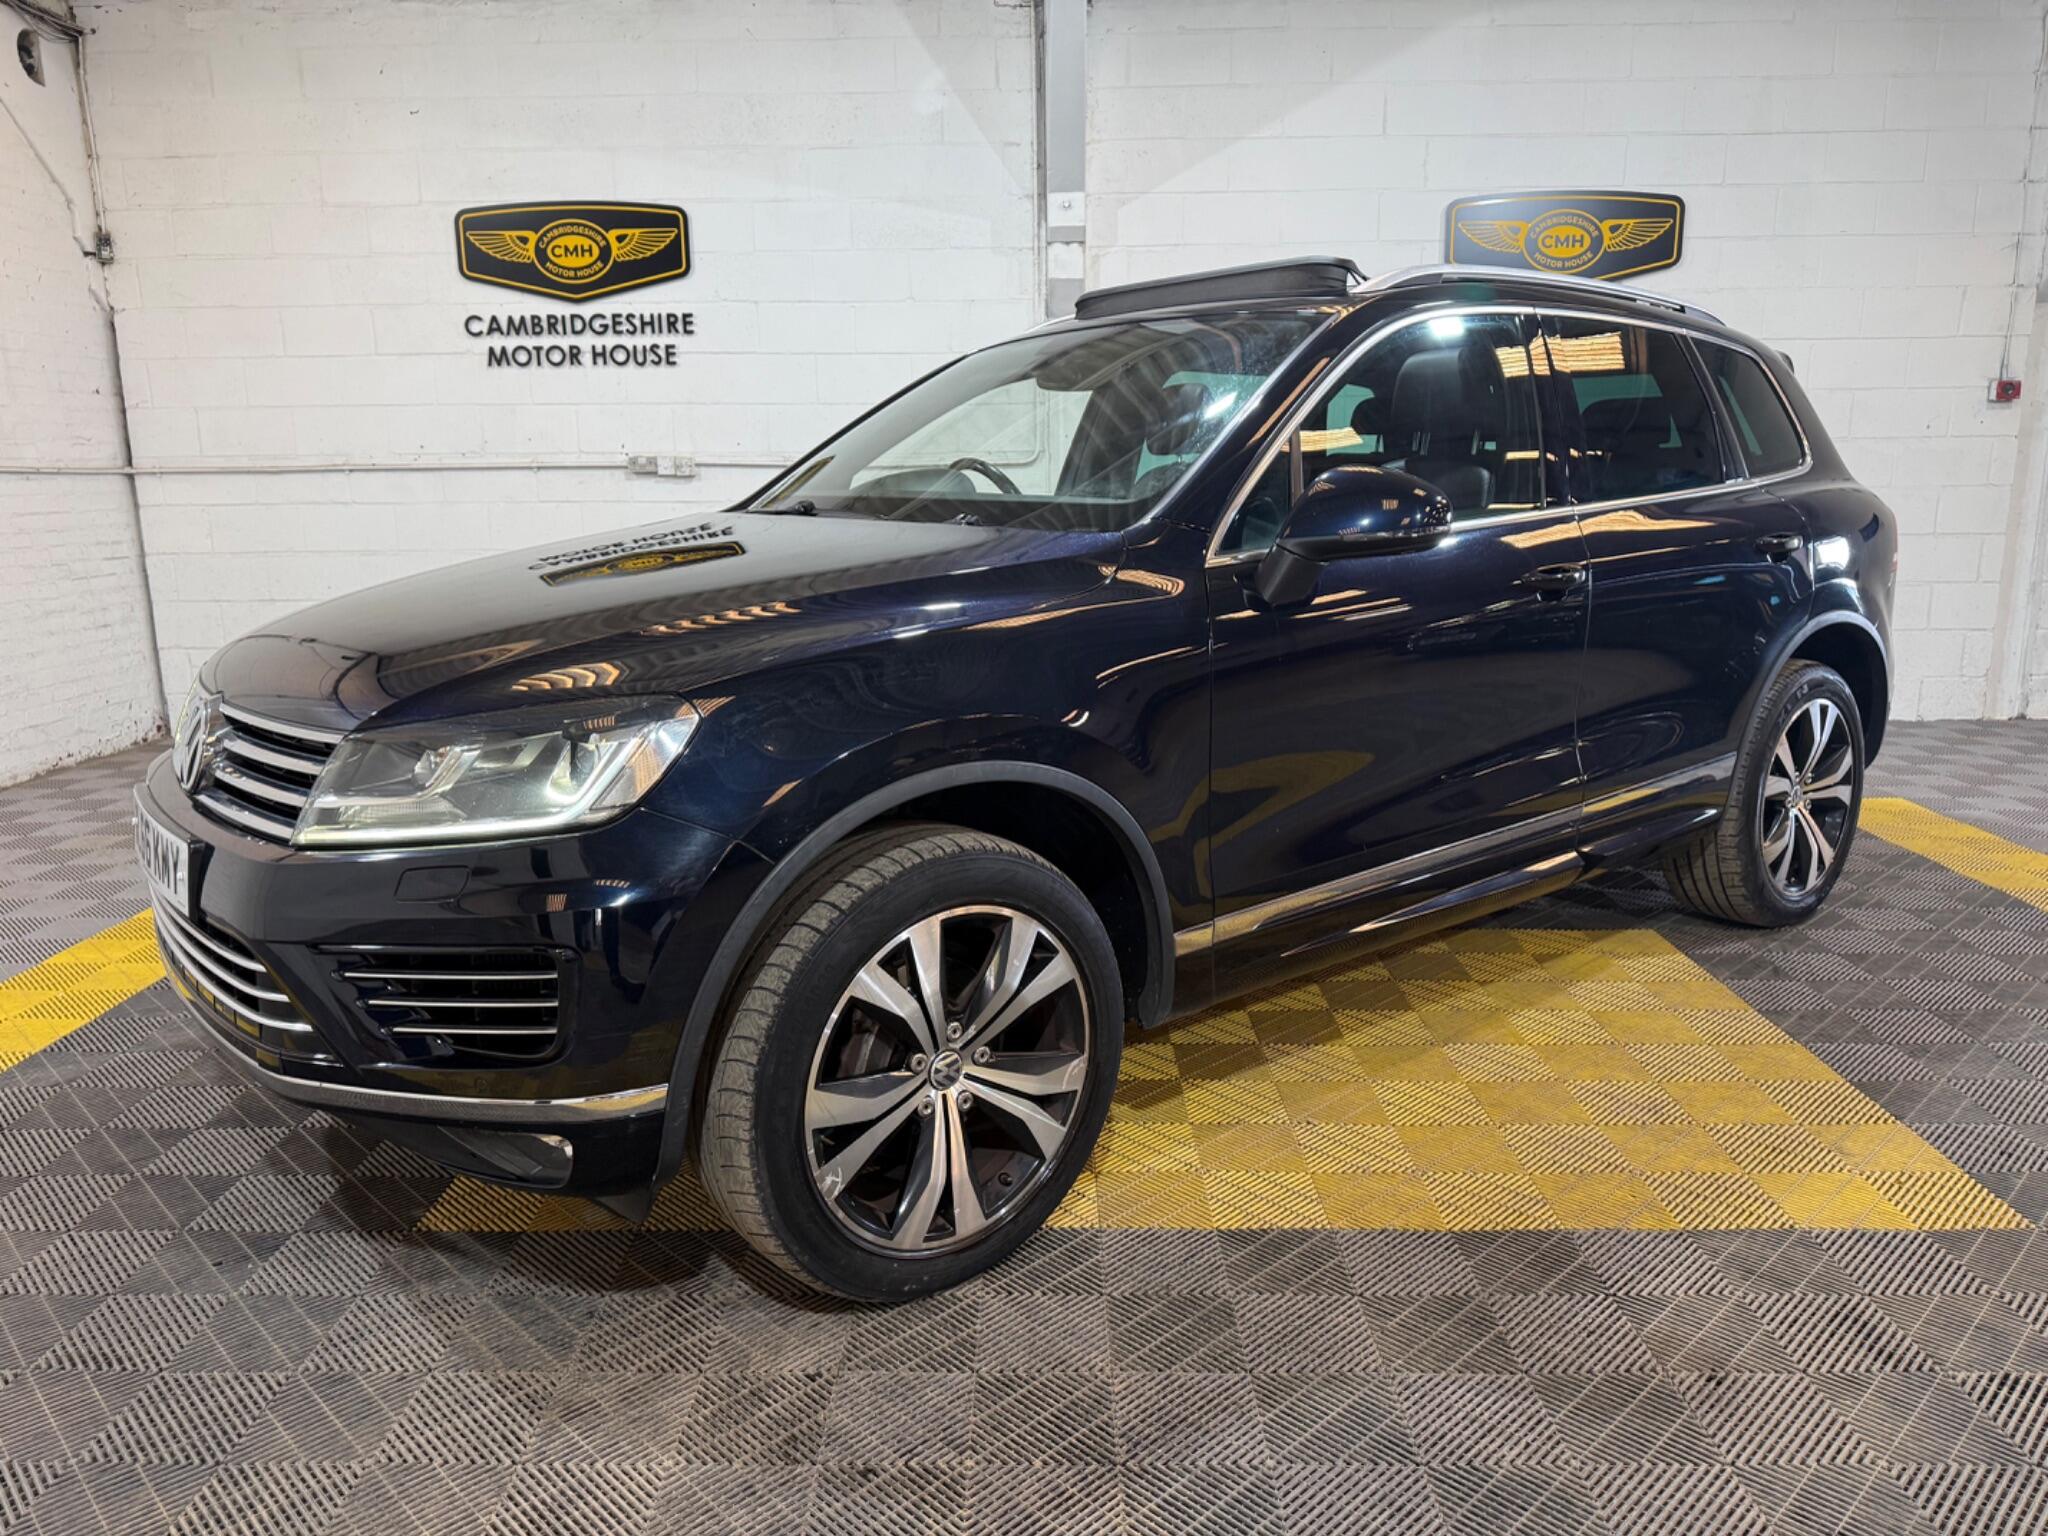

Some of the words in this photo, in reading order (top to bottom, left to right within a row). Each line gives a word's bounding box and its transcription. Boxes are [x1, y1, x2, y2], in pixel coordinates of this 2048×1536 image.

[539, 224, 607, 248] CAMBRIDGESHIRE
[1530, 215, 1599, 238] CAMBRIDGESHIRE
[551, 244, 593, 258] CMH
[1541, 234, 1585, 248] CMH
[545, 261, 576, 278] MOTOR
[576, 260, 605, 278] HOUSE
[1534, 251, 1563, 268] MOTOR
[1564, 250, 1594, 268] HOUSE
[464, 313, 695, 337] CAMBRIDGESHIRE
[487, 345, 583, 368] MOTOR
[591, 343, 678, 367] HOUSE
[153, 825, 180, 895] KMY
